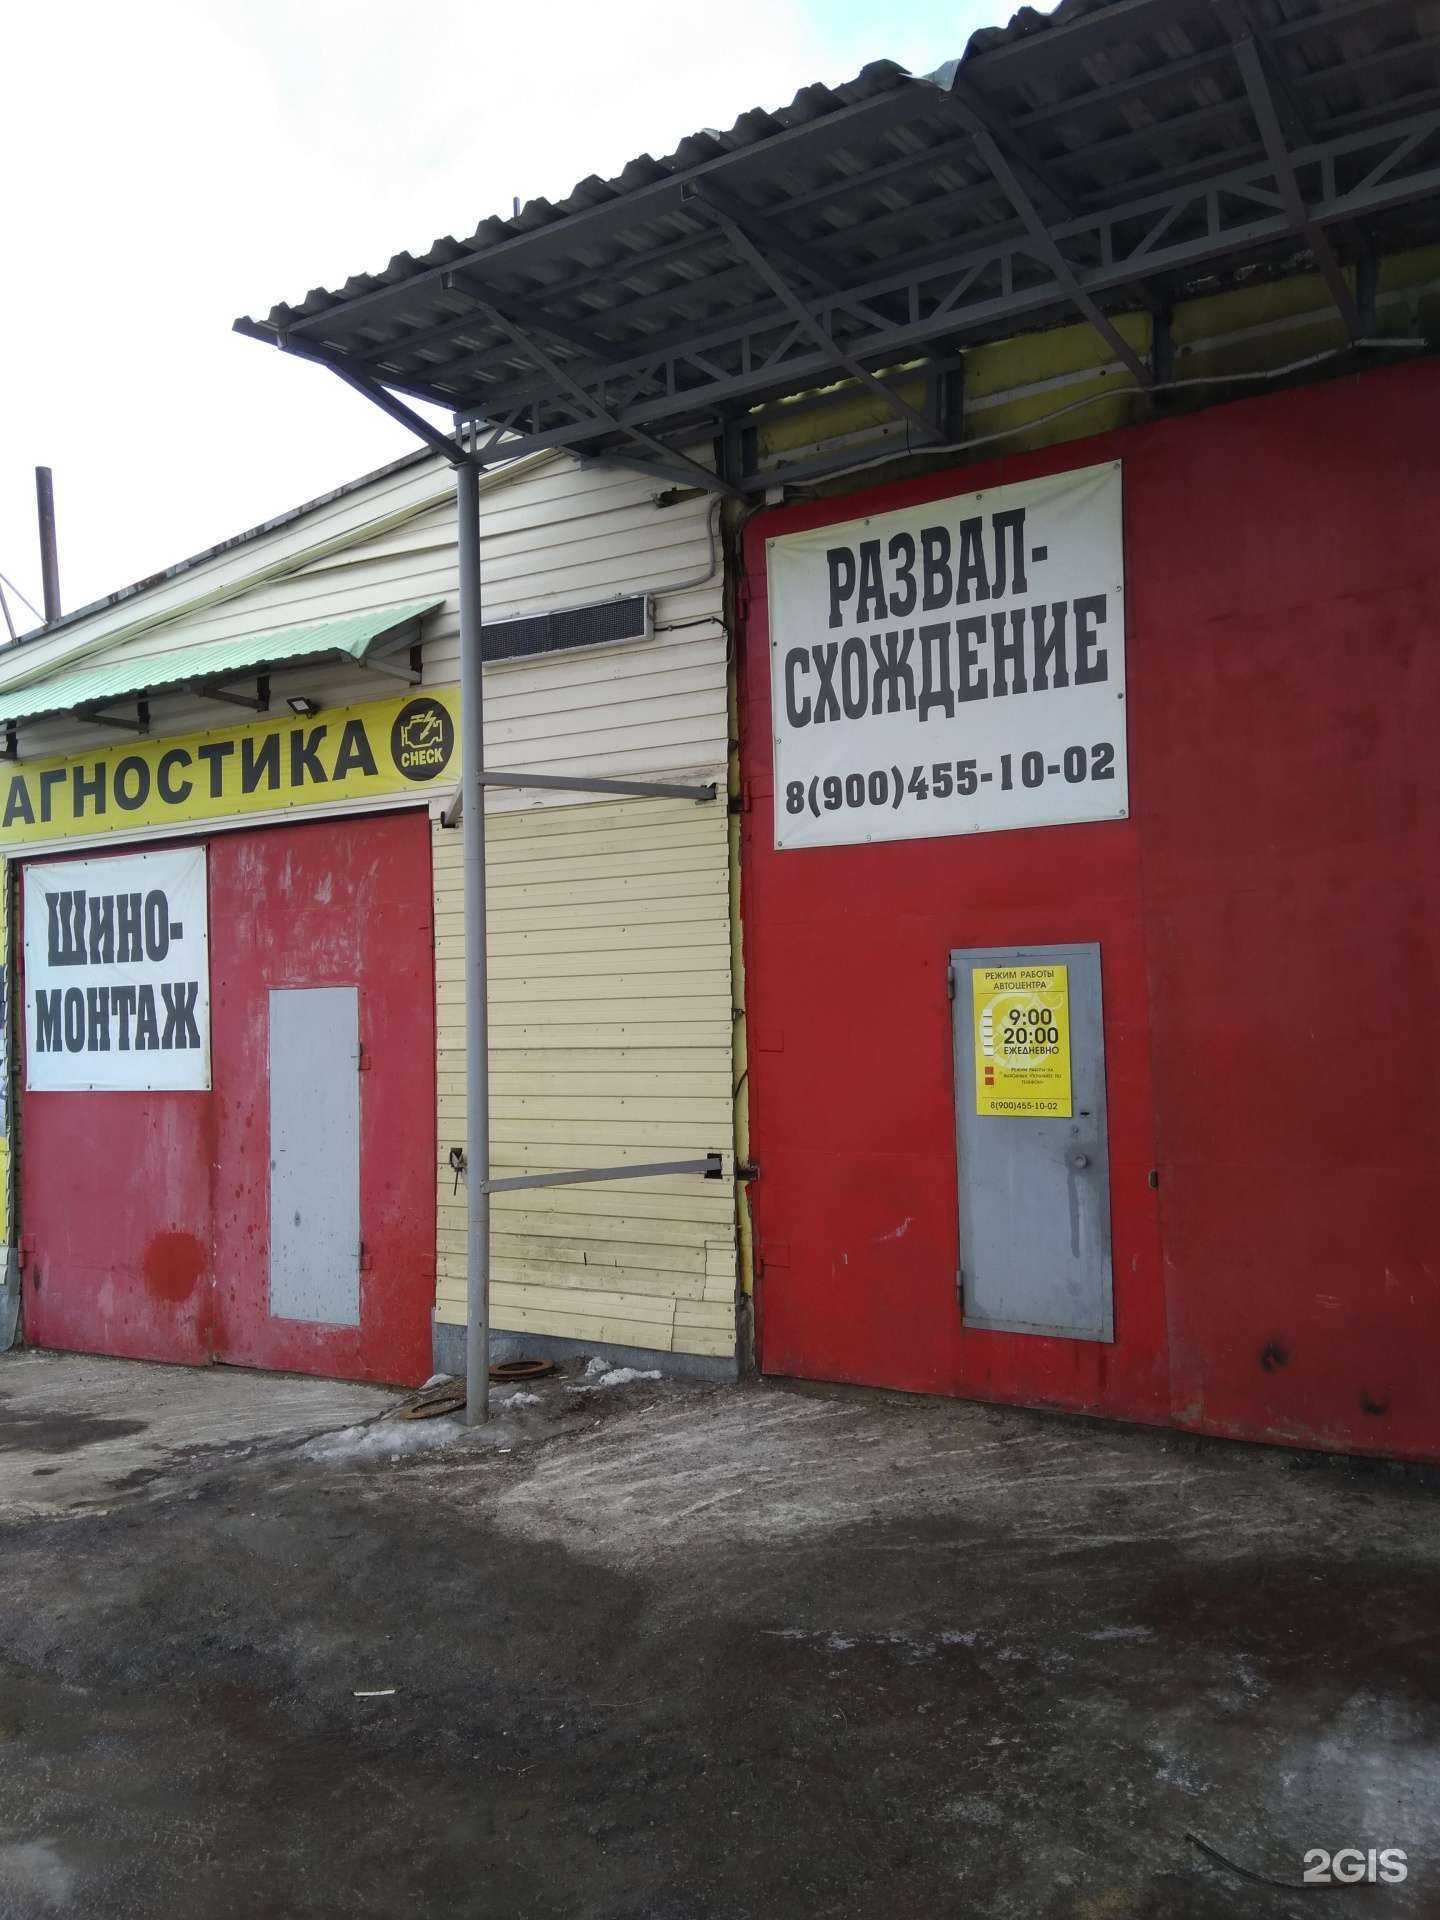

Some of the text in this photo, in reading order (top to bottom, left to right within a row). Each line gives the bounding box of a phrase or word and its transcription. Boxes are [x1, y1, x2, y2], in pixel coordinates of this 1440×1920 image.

[826, 508, 1047, 628] РАЗВАЛ-
[785, 594, 1108, 728] СХОЖДЕНИЕ
[401, 748, 444, 769] CHECK
[2, 719, 378, 828] АГНОСТИКА
[786, 742, 1115, 818] 8(900)455-10-02
[46, 889, 183, 968] ШИНО-
[985, 970, 1055, 980] РЕЖИМ РАБОТЫ
[993, 981, 1047, 991] АВТОЦЕНТРА
[35, 981, 201, 1053] МОНТАЖ
[1009, 1008, 1052, 1026] 9:00
[1003, 1027, 1059, 1045] 20:00
[1003, 1046, 1060, 1055] ЕЖЕДНЕВНО
[990, 1101, 1058, 1110] 8(900)455-10-02
